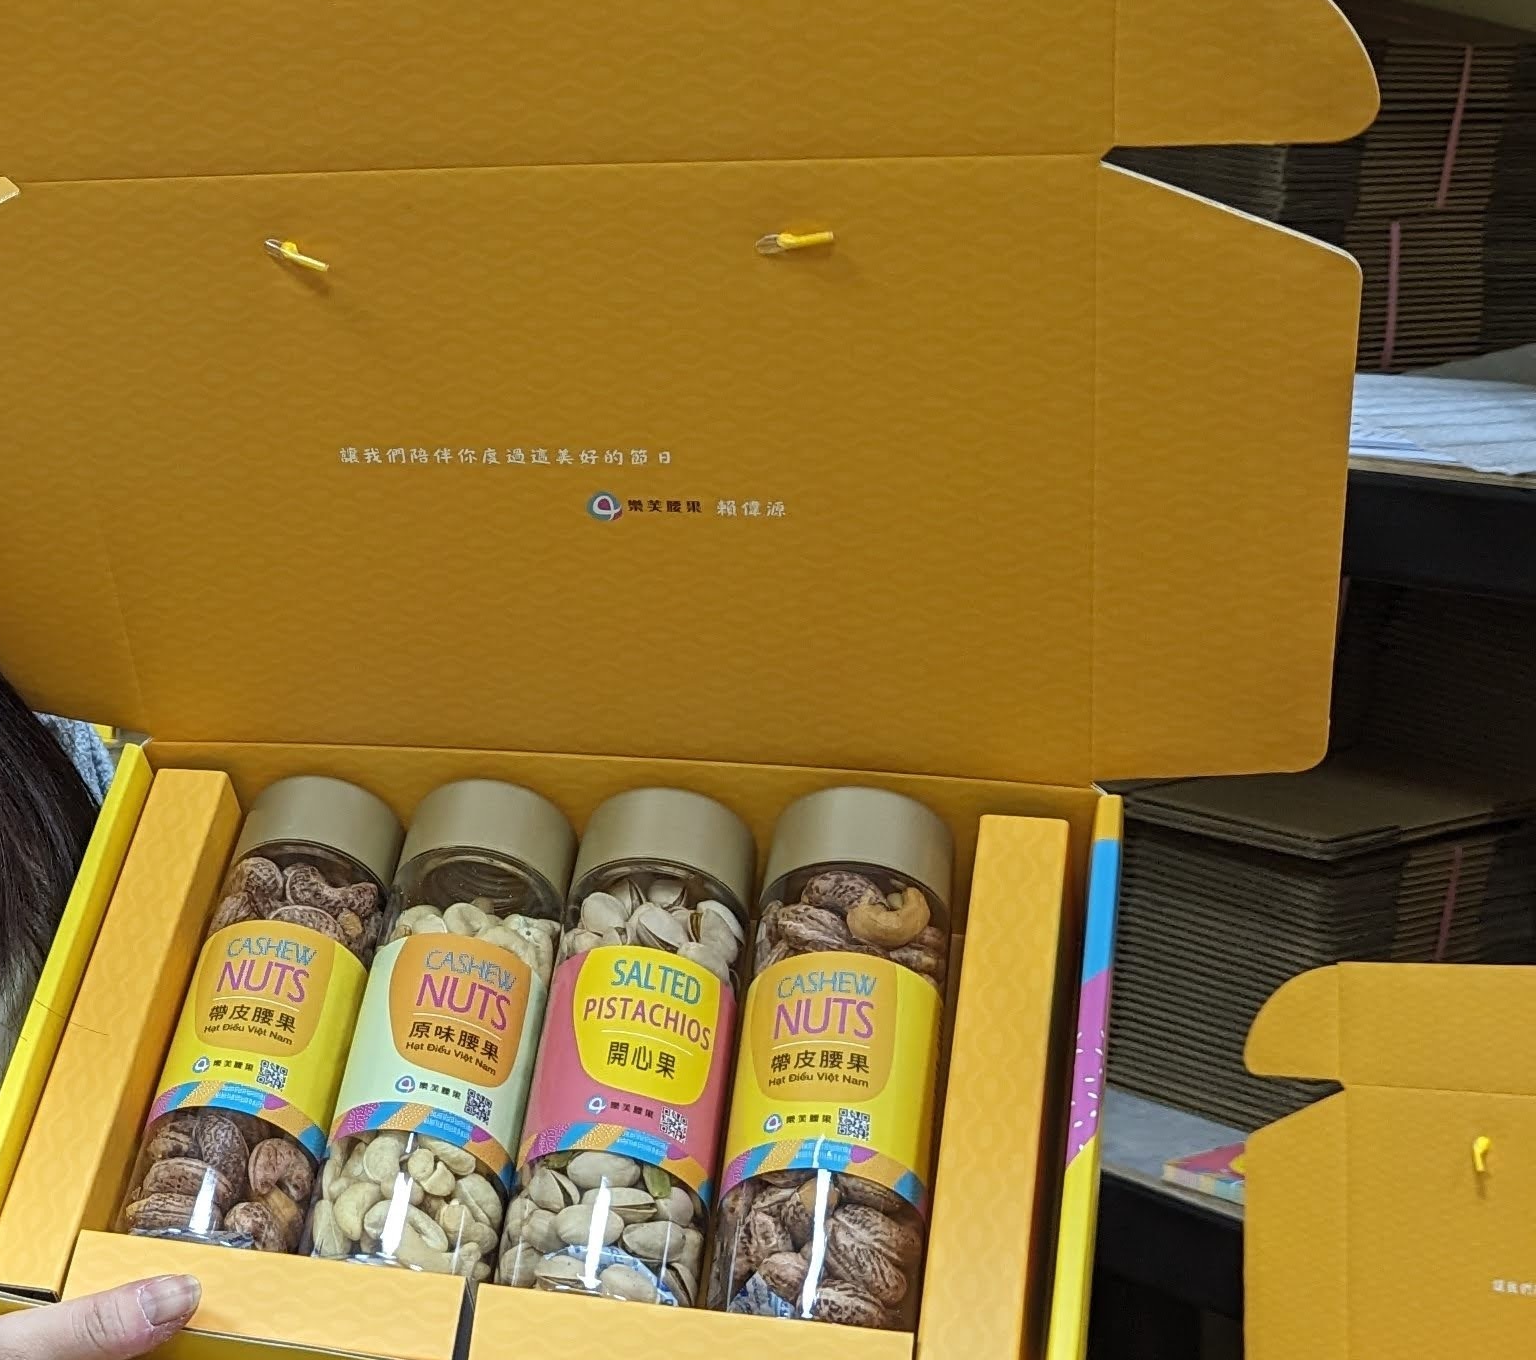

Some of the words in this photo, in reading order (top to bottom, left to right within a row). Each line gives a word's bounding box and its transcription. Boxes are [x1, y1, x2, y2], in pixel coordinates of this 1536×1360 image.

[227, 937, 317, 966] CASHEW
[425, 949, 517, 991] CASHEW
[216, 959, 310, 1003] NUTS
[611, 959, 701, 1005] SALTED
[777, 970, 877, 998] CASHEW
[208, 1004, 296, 1034] 帶皮腰果
[415, 973, 511, 1031] NUTS
[773, 997, 874, 1040] NUTS
[268, 1031, 293, 1046] Nam
[408, 1021, 499, 1064] 原味腰果
[582, 996, 712, 1051] PISTACHIOS
[474, 1060, 497, 1076] Nam
[606, 1040, 676, 1080] 開心果
[770, 1049, 870, 1074] 帶皮腰果
[842, 1075, 869, 1088] Nam
